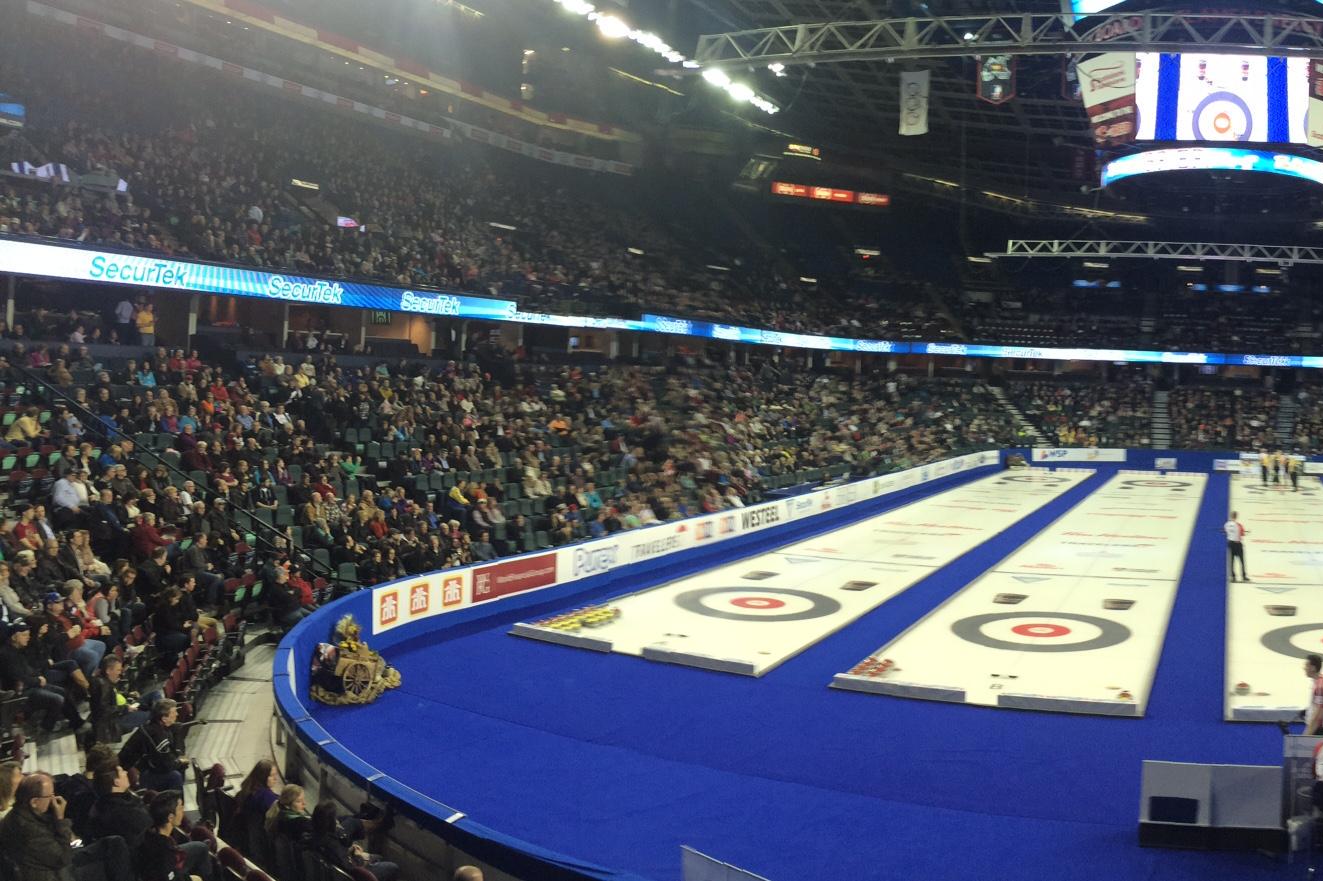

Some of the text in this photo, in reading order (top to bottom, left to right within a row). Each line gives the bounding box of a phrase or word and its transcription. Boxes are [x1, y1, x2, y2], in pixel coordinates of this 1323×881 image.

[89, 255, 188, 287] SecurTek
[268, 275, 344, 304] SecurTek
[401, 291, 461, 315] SecurTek
[741, 505, 780, 530] WESTEEL
